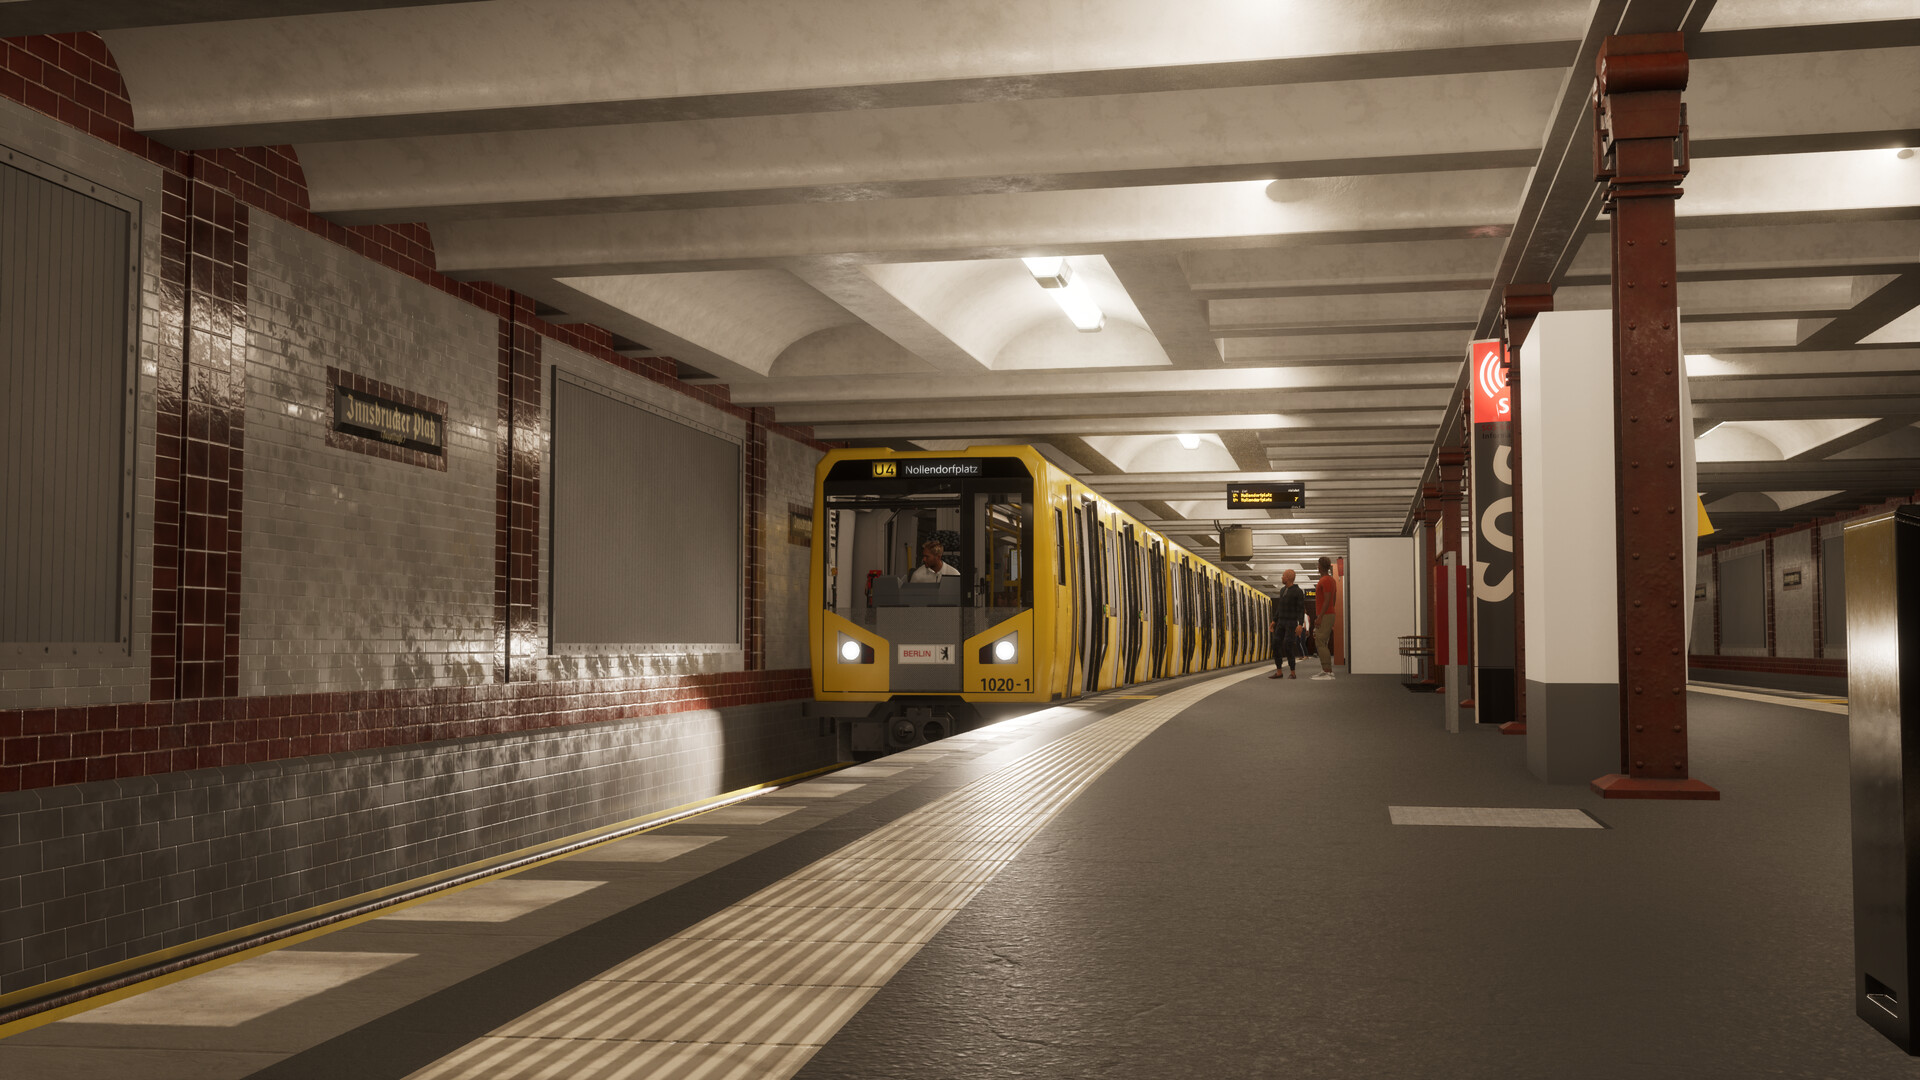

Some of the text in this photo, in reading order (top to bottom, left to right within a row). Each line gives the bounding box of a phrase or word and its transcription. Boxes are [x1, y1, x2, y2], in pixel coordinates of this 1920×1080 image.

[346, 393, 411, 433] Innsbrucker
[874, 463, 978, 476] U4 Nollendorfplatz
[903, 649, 931, 658] BERLIN
